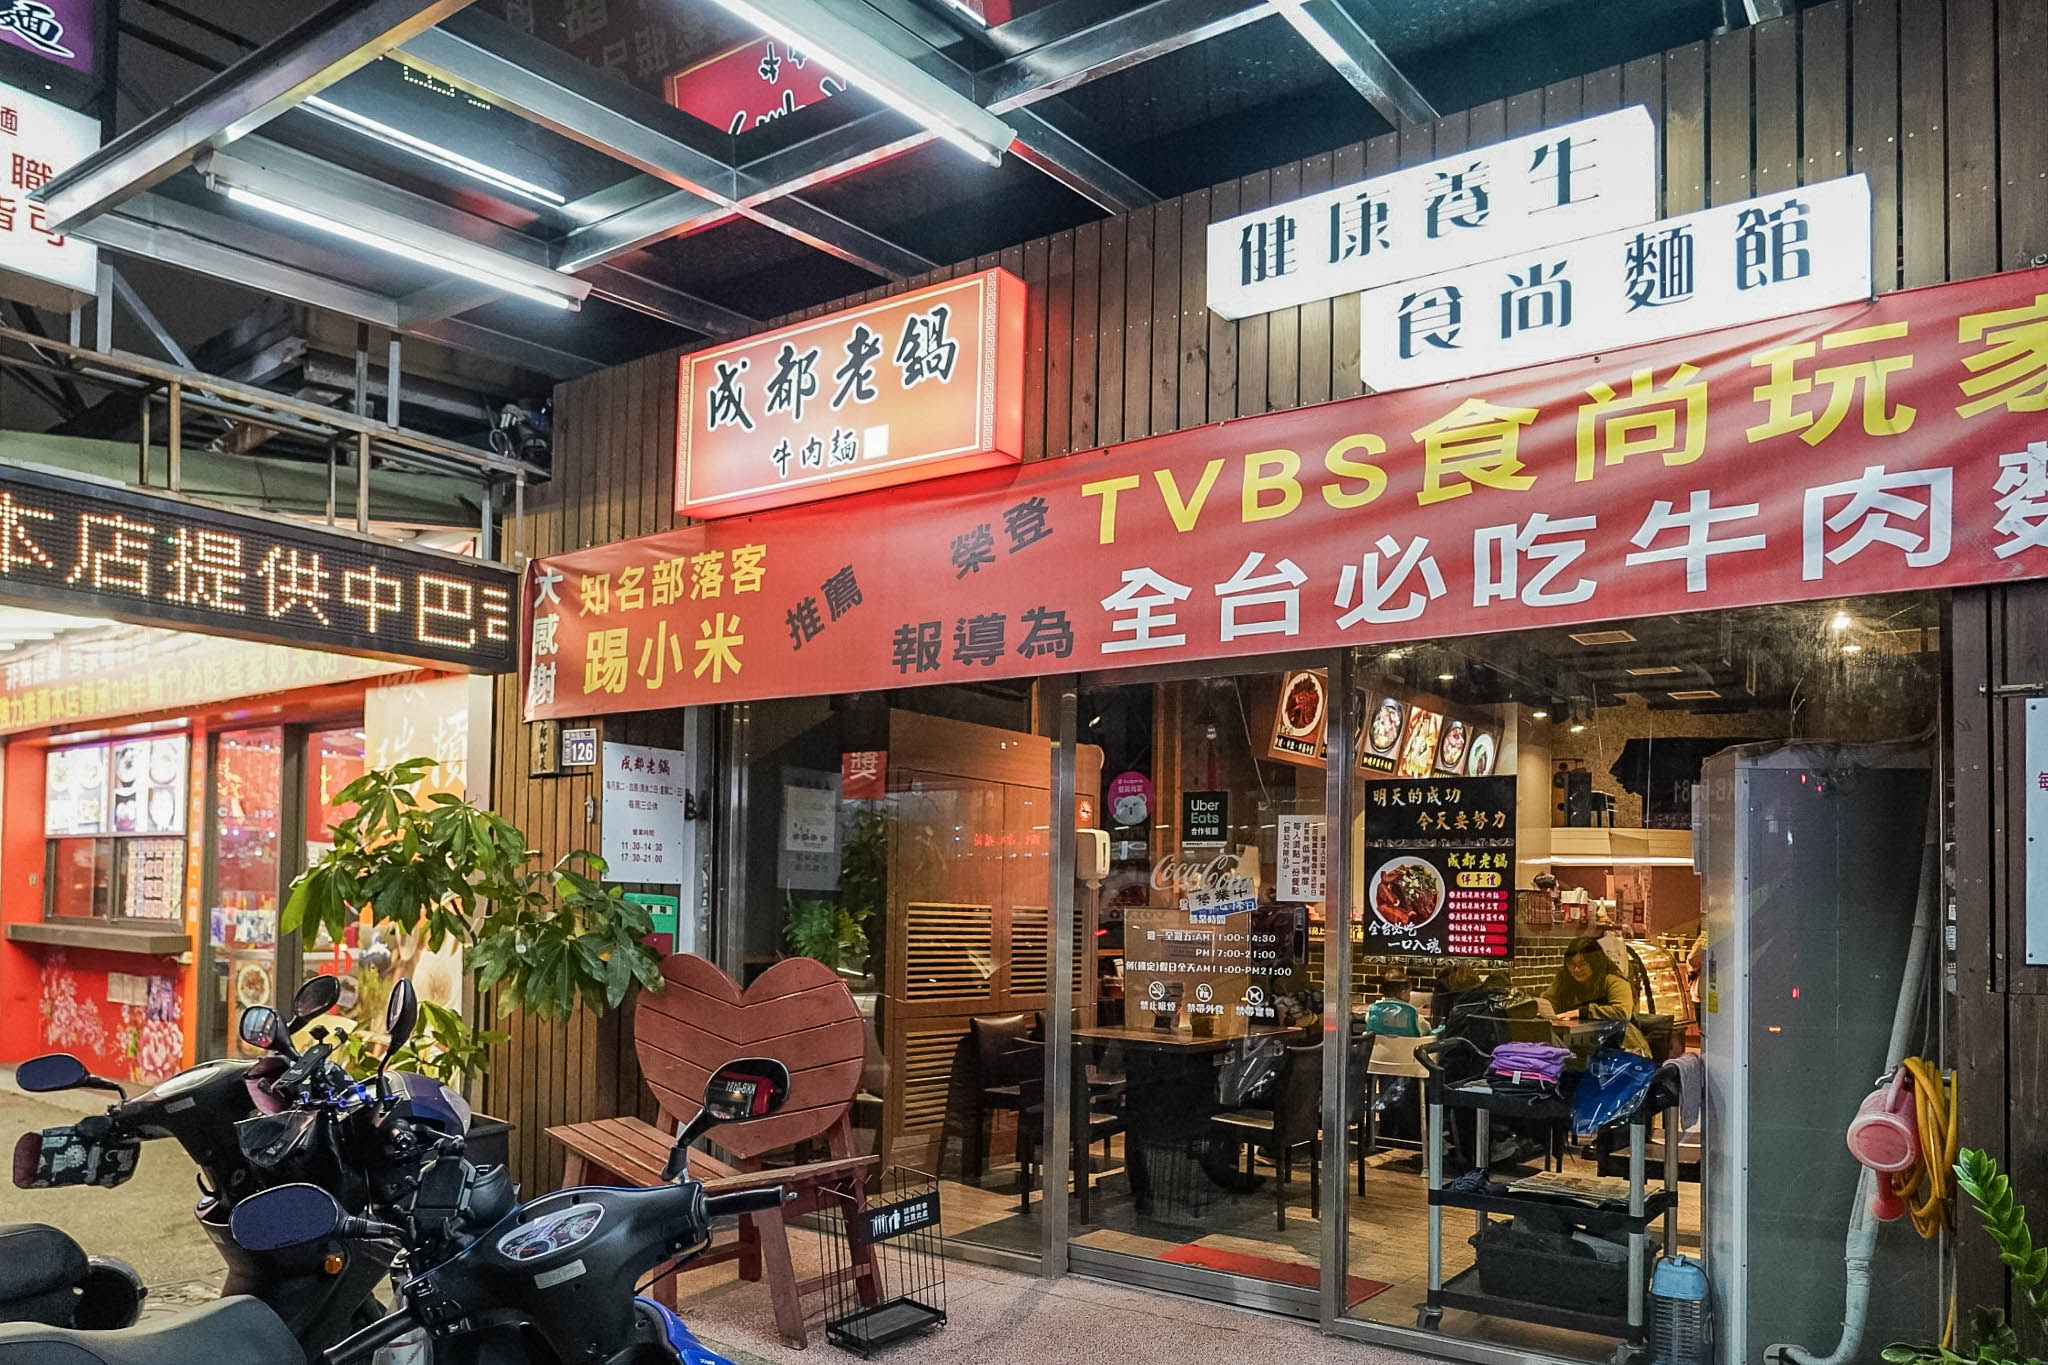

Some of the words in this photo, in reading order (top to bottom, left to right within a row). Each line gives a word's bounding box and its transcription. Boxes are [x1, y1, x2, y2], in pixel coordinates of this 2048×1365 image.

[1239, 137, 1599, 286] 健康養生
[1396, 198, 1812, 360] 食尚麵館
[709, 306, 958, 430] 成都老鍋
[950, 496, 1052, 580] 榮登
[579, 543, 768, 617] 知名部落客
[785, 564, 864, 652] 推薦
[583, 611, 745, 696] 踢小米
[892, 605, 1075, 674] 報導為
[572, 742, 594, 762] 126
[1191, 799, 1220, 811] Uber
[1191, 812, 1220, 824] Eats
[1372, 785, 1462, 808] 明天的成功
[1416, 810, 1507, 831] 今天要努力
[1447, 851, 1509, 870] 成都老鍋
[1368, 920, 1417, 937] 全台必吃
[1387, 937, 1442, 954] 一口入魂
